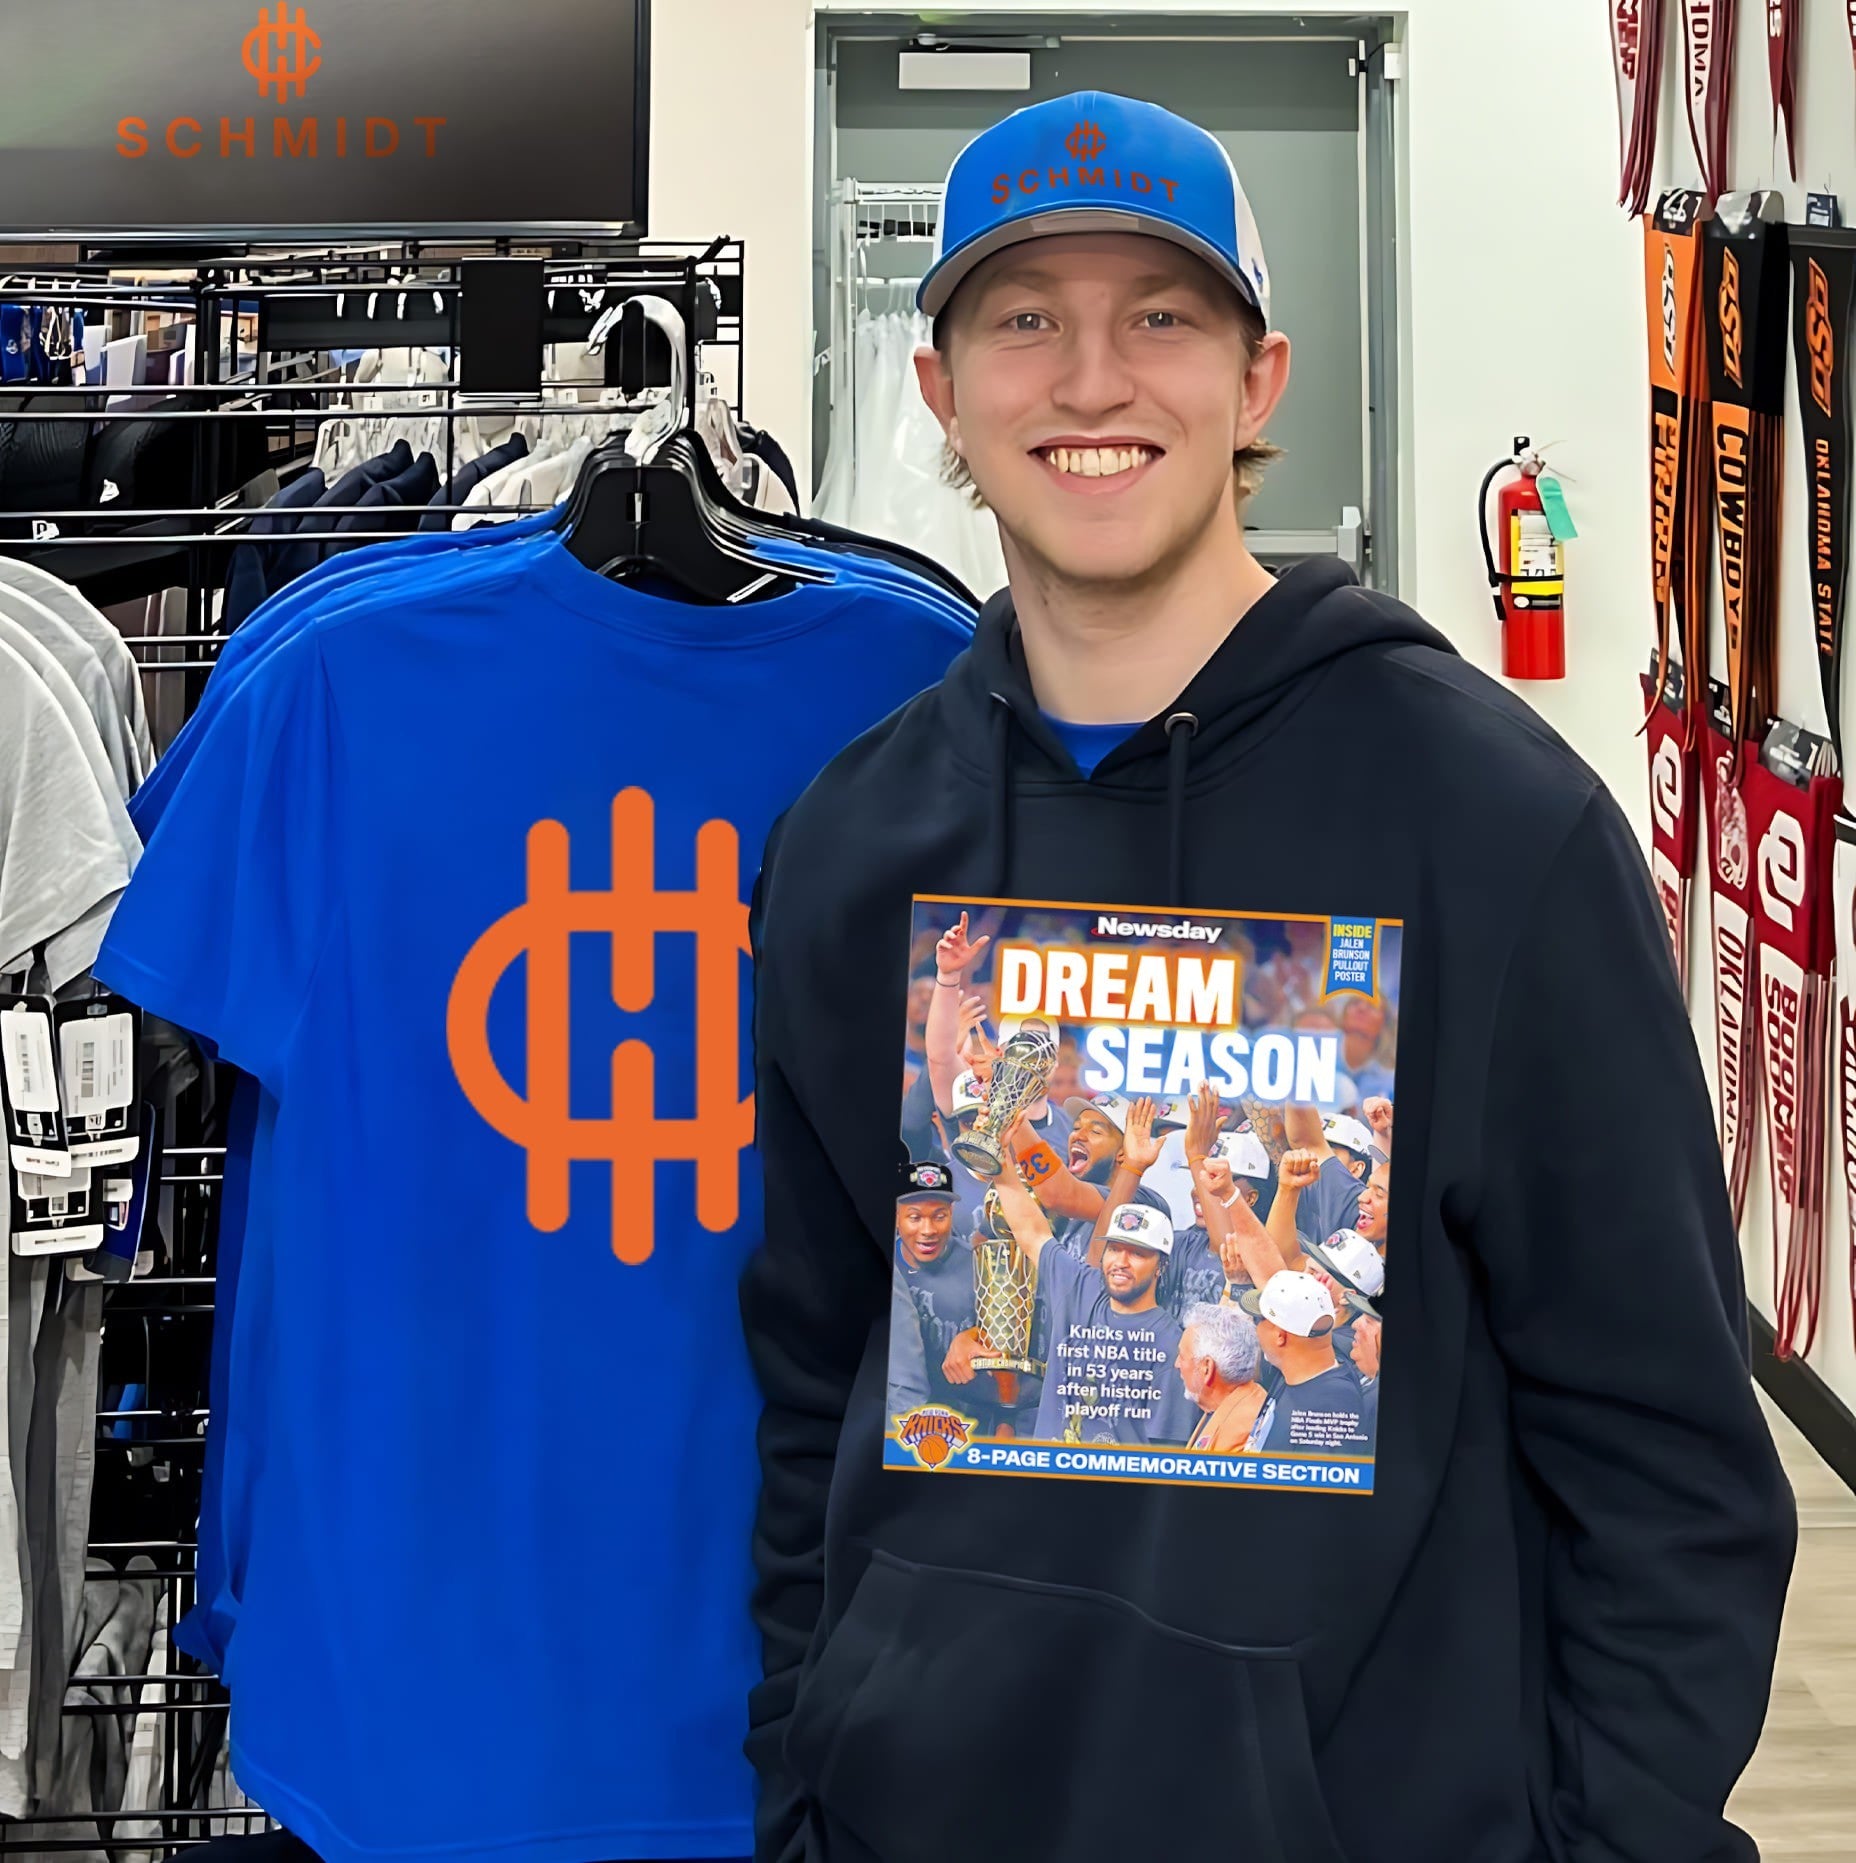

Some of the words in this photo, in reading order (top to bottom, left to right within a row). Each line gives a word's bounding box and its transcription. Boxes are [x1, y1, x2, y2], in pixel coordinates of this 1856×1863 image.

[115, 117, 447, 158] SCHMIDT
[991, 167, 1179, 204] SCHMIDT
[1815, 438, 1832, 571] OKLAHOMA
[1097, 916, 1222, 943] Newsday
[1333, 924, 1373, 938] INSIDE
[1340, 938, 1364, 949] JALEN
[1332, 949, 1370, 960] BRUNSON
[1333, 960, 1369, 971] PULLOUT
[1334, 971, 1366, 982] POSTER
[1000, 948, 1235, 1025] DREAM
[1085, 1027, 1337, 1102] SEASON
[1070, 1324, 1123, 1341] Knicks
[1127, 1328, 1155, 1343] win
[1056, 1343, 1090, 1359] first
[1094, 1345, 1129, 1360] NBA
[1133, 1347, 1167, 1362] title
[1067, 1362, 1082, 1377] in
[1086, 1363, 1107, 1378] 53
[1110, 1367, 1154, 1382] years
[1056, 1381, 1097, 1397] after
[1101, 1384, 1161, 1400] historic
[1065, 1402, 1121, 1420] playoff
[1124, 1407, 1151, 1419] run
[900, 1413, 967, 1443] KNICKS
[967, 1448, 1050, 1468] 8-PAGE
[1055, 1452, 1257, 1479] COMMEMORATIVE
[1262, 1463, 1360, 1484] SECTION
